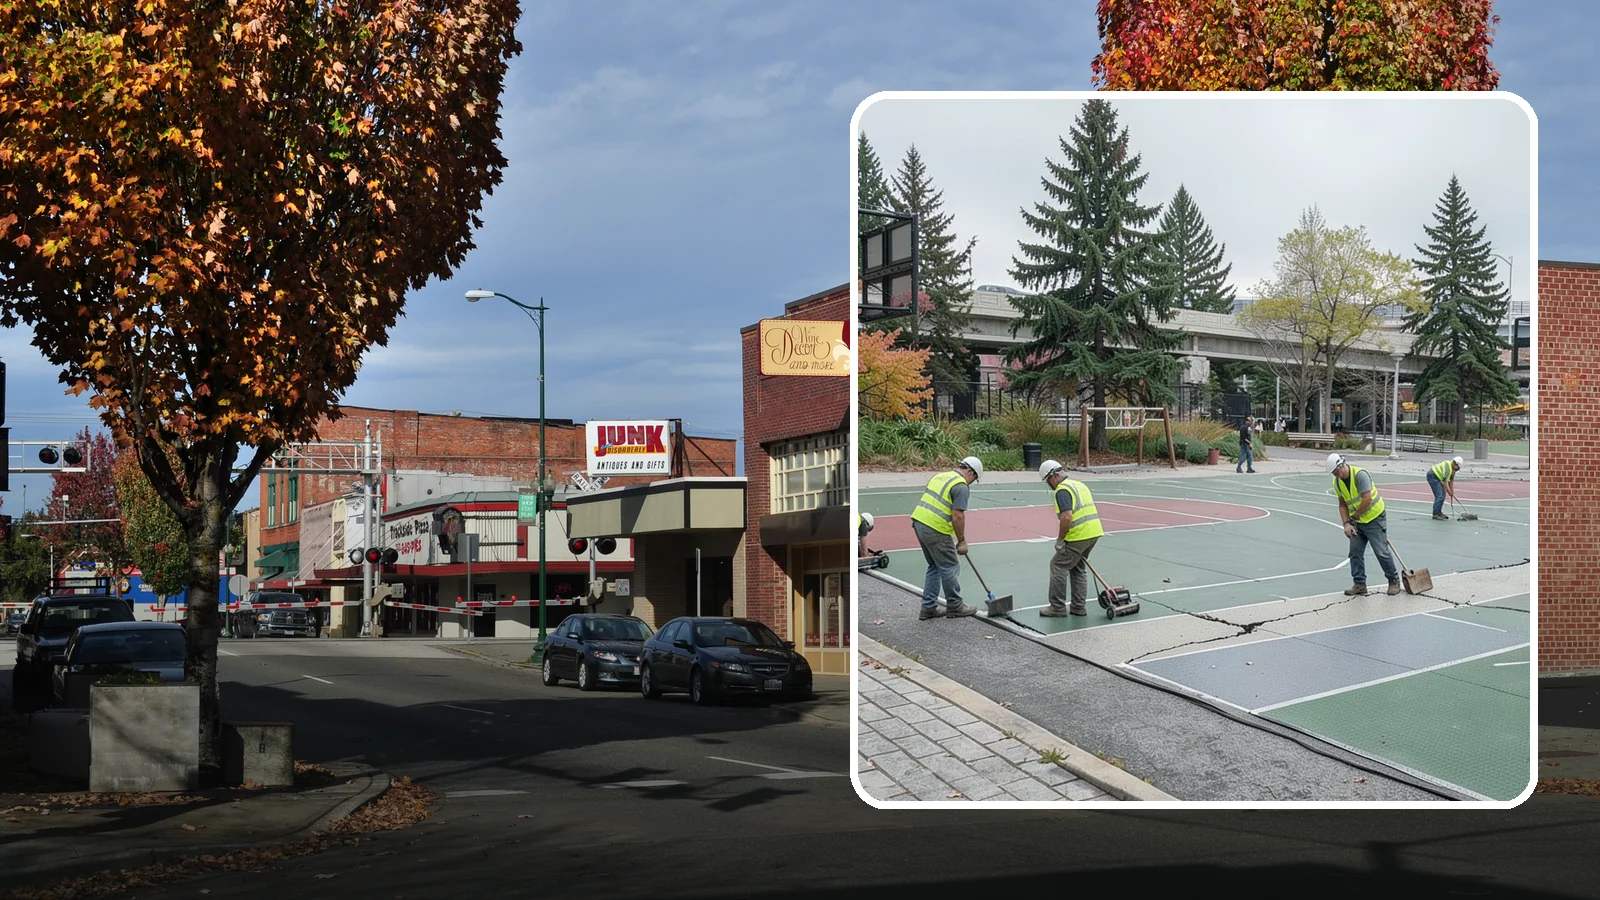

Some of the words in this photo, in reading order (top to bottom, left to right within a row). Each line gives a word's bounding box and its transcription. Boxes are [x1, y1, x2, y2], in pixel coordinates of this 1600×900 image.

[595, 425, 665, 457] JUNK
[607, 446, 646, 454] DISORDERLY
[597, 461, 628, 470] ANTIQUES
[631, 461, 644, 470] AND
[647, 460, 665, 469] GIFTS
[573, 473, 589, 492] RAIL
[414, 519, 429, 535] Pizza
